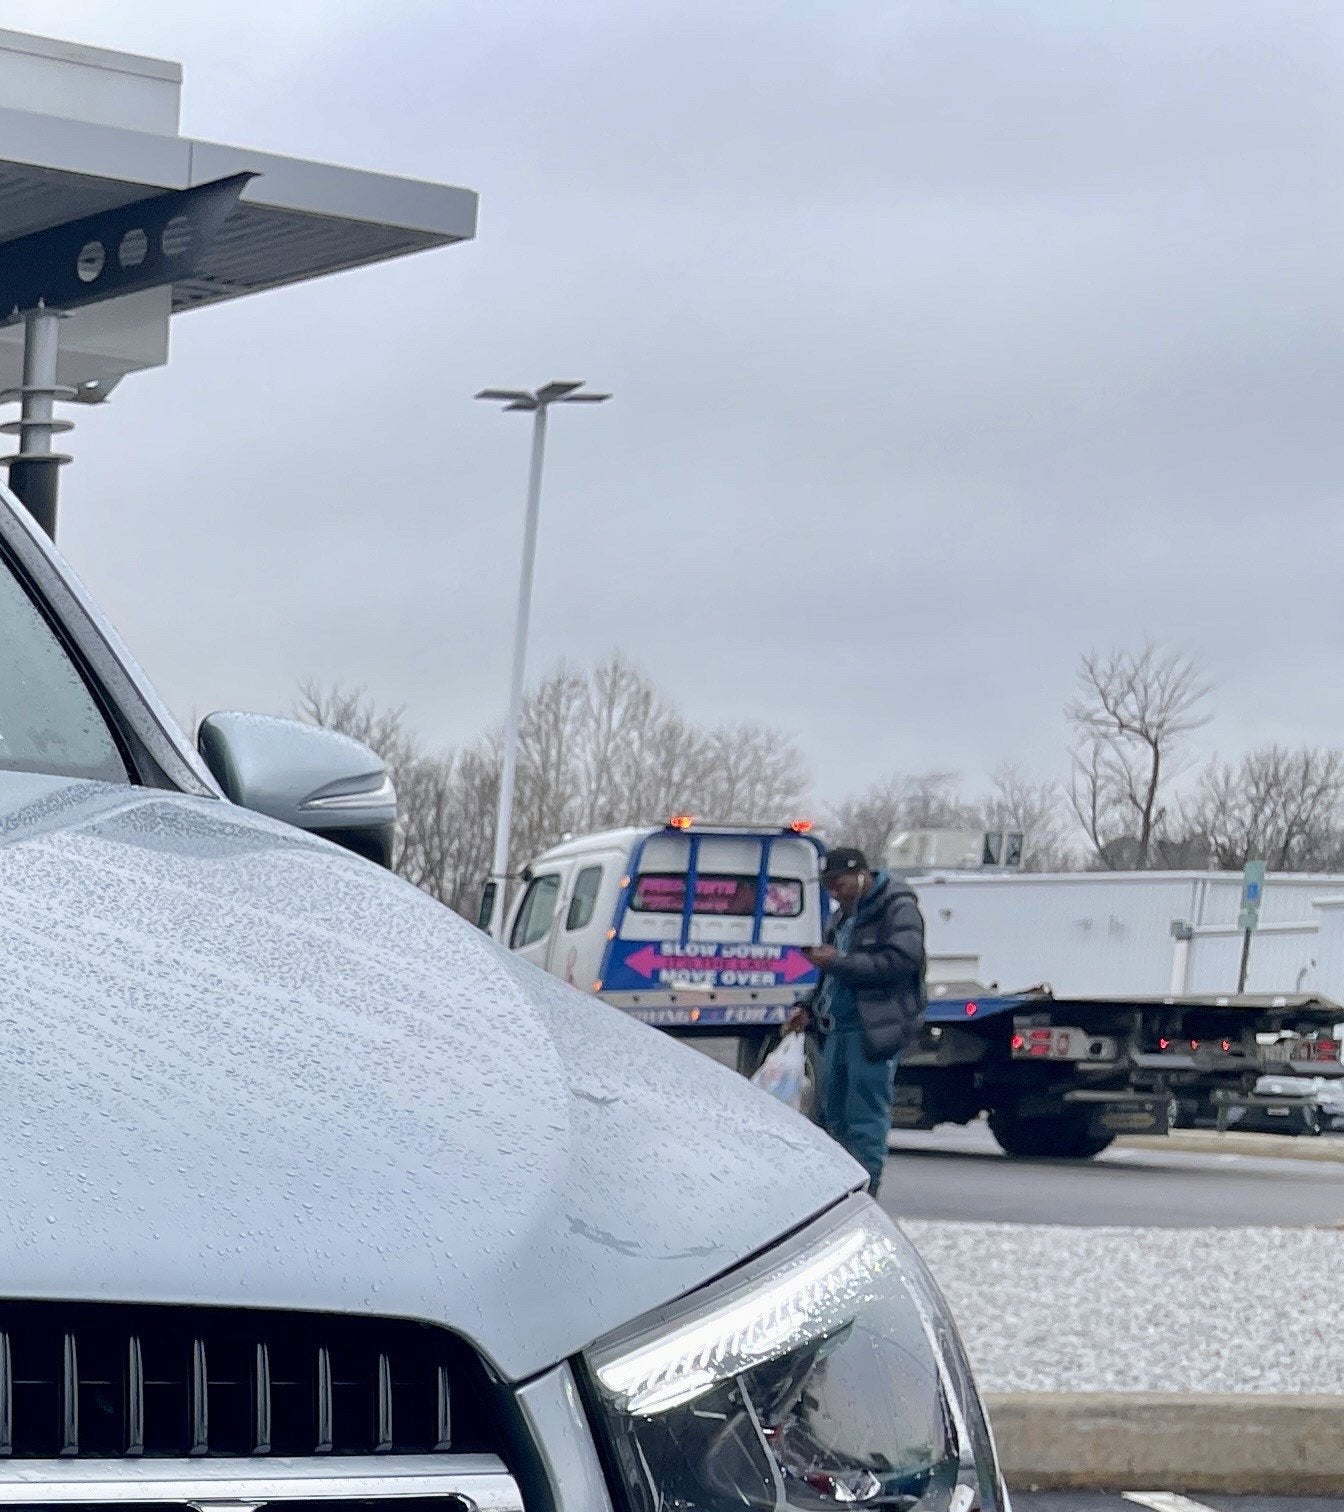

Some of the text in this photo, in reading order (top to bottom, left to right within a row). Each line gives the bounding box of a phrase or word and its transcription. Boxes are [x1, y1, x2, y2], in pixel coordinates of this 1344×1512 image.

[662, 943, 781, 959] SLOW DOWN
[660, 969, 776, 986] MOVE OVER
